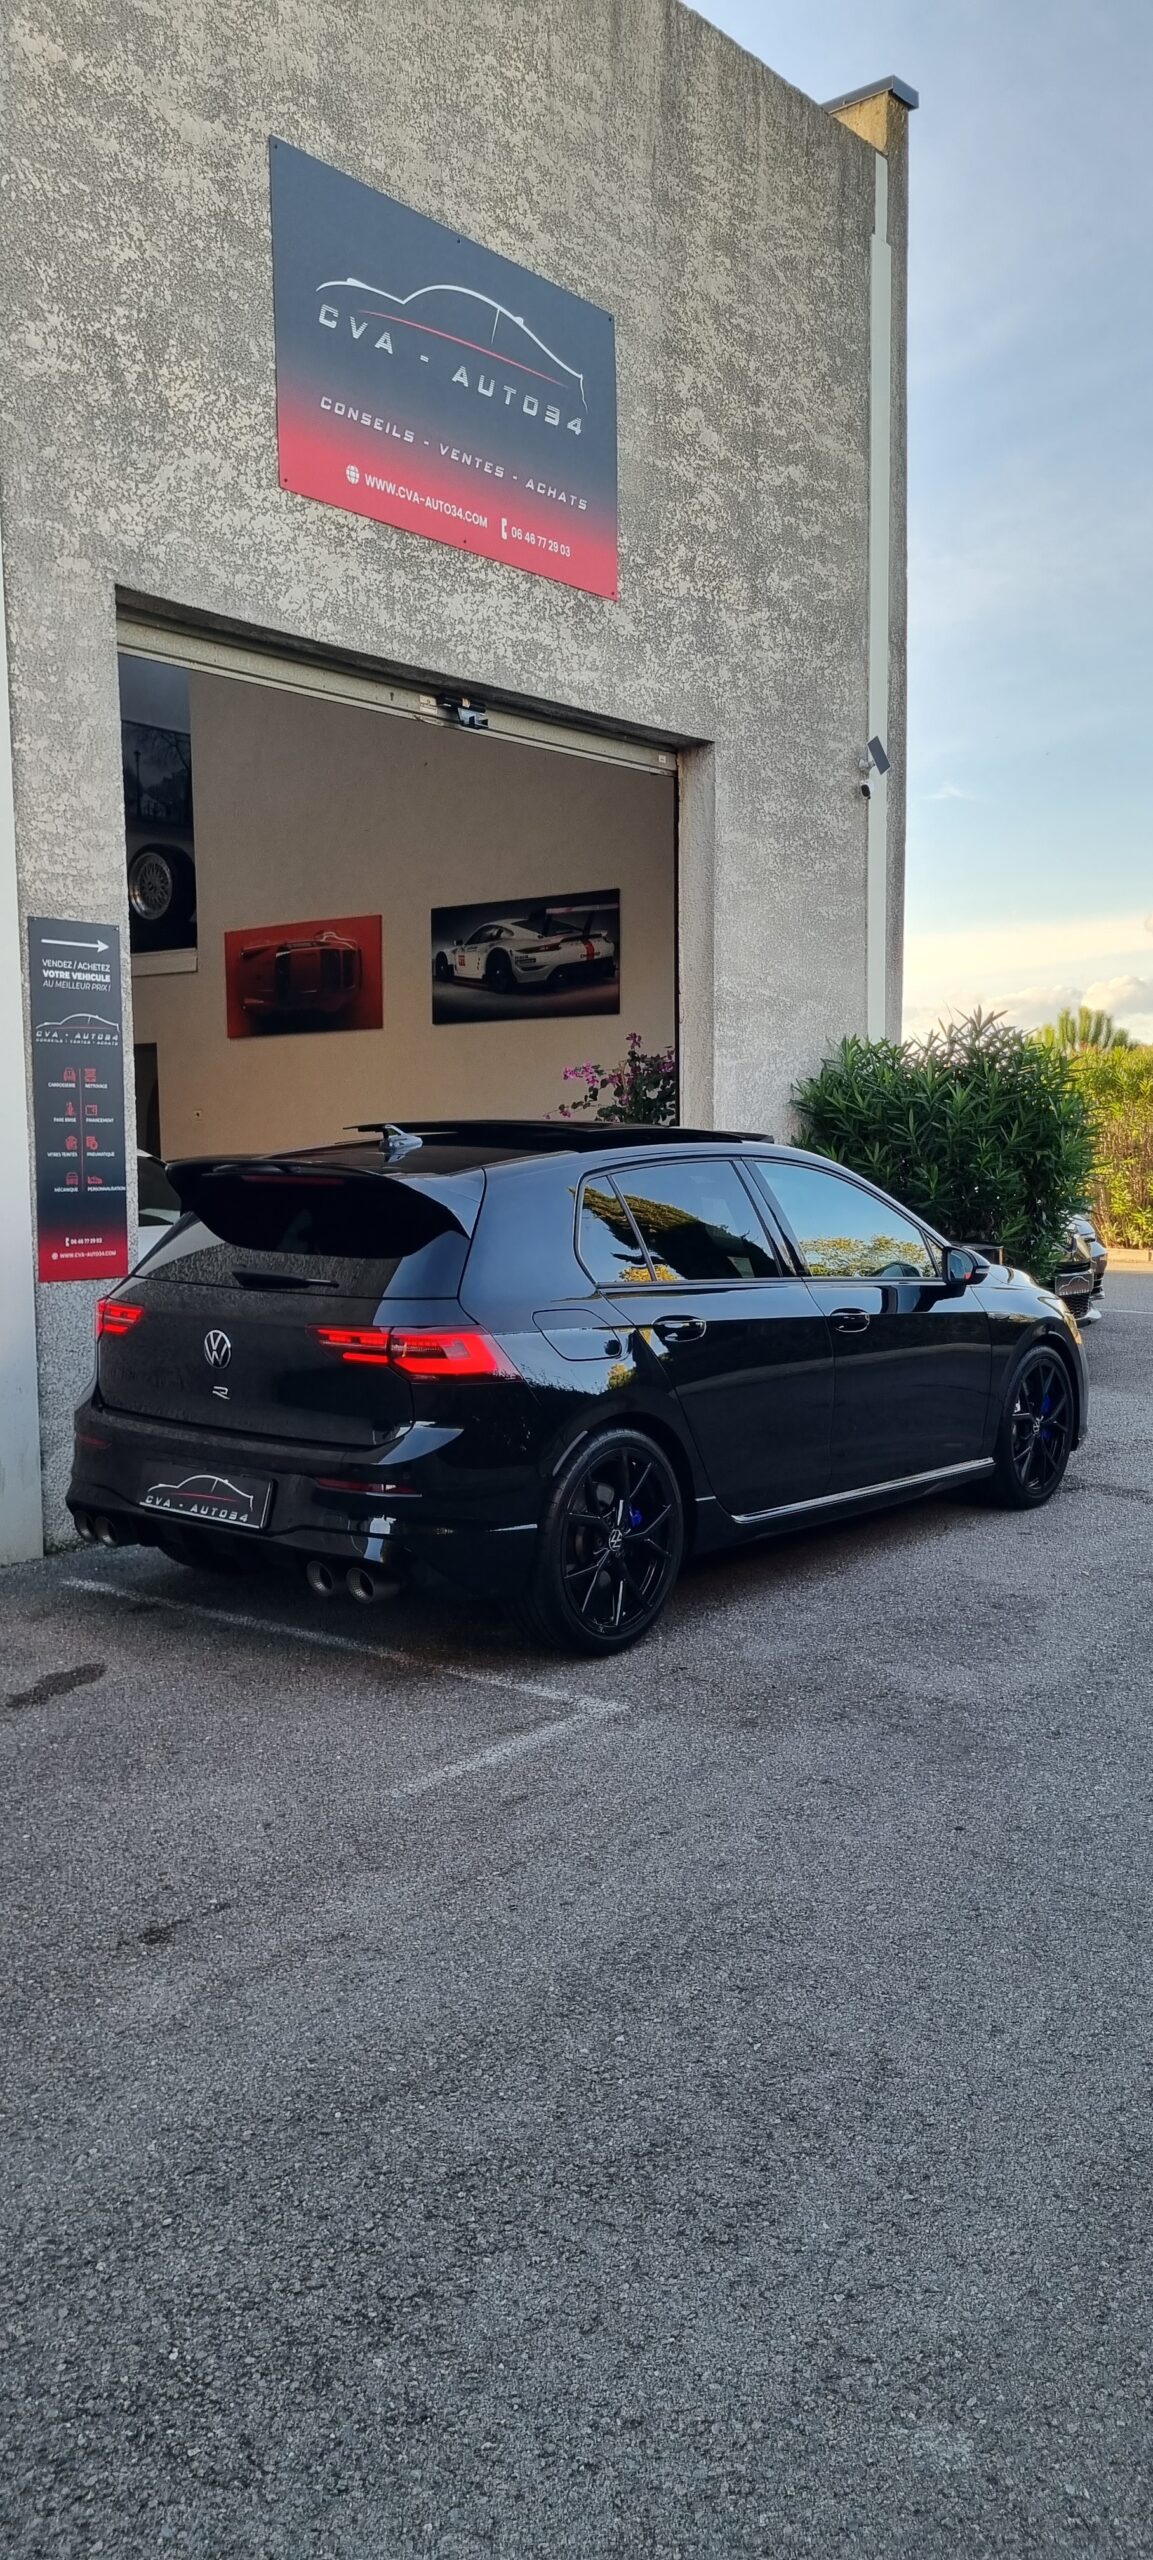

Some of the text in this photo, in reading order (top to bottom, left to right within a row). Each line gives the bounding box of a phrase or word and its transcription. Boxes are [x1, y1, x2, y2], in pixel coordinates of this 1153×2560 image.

[318, 304, 393, 354] CVA
[451, 365, 582, 435] AUTO34
[320, 396, 415, 443] CONSEILS
[439, 443, 505, 478] VENTES
[525, 478, 588, 511] ACHATS
[364, 473, 488, 528] WWW.CVA-AUTO34.COM
[511, 526, 570, 557] 06 46 77 29 03
[42, 959, 72, 969] VENDEZ
[77, 962, 110, 972] ACHETEZ
[42, 969, 111, 982] VOTRE VEHICULE
[55, 981, 90, 990] MEILLEUR
[145, 1495, 170, 1507] CVA
[190, 1504, 248, 1522] AUTO34
